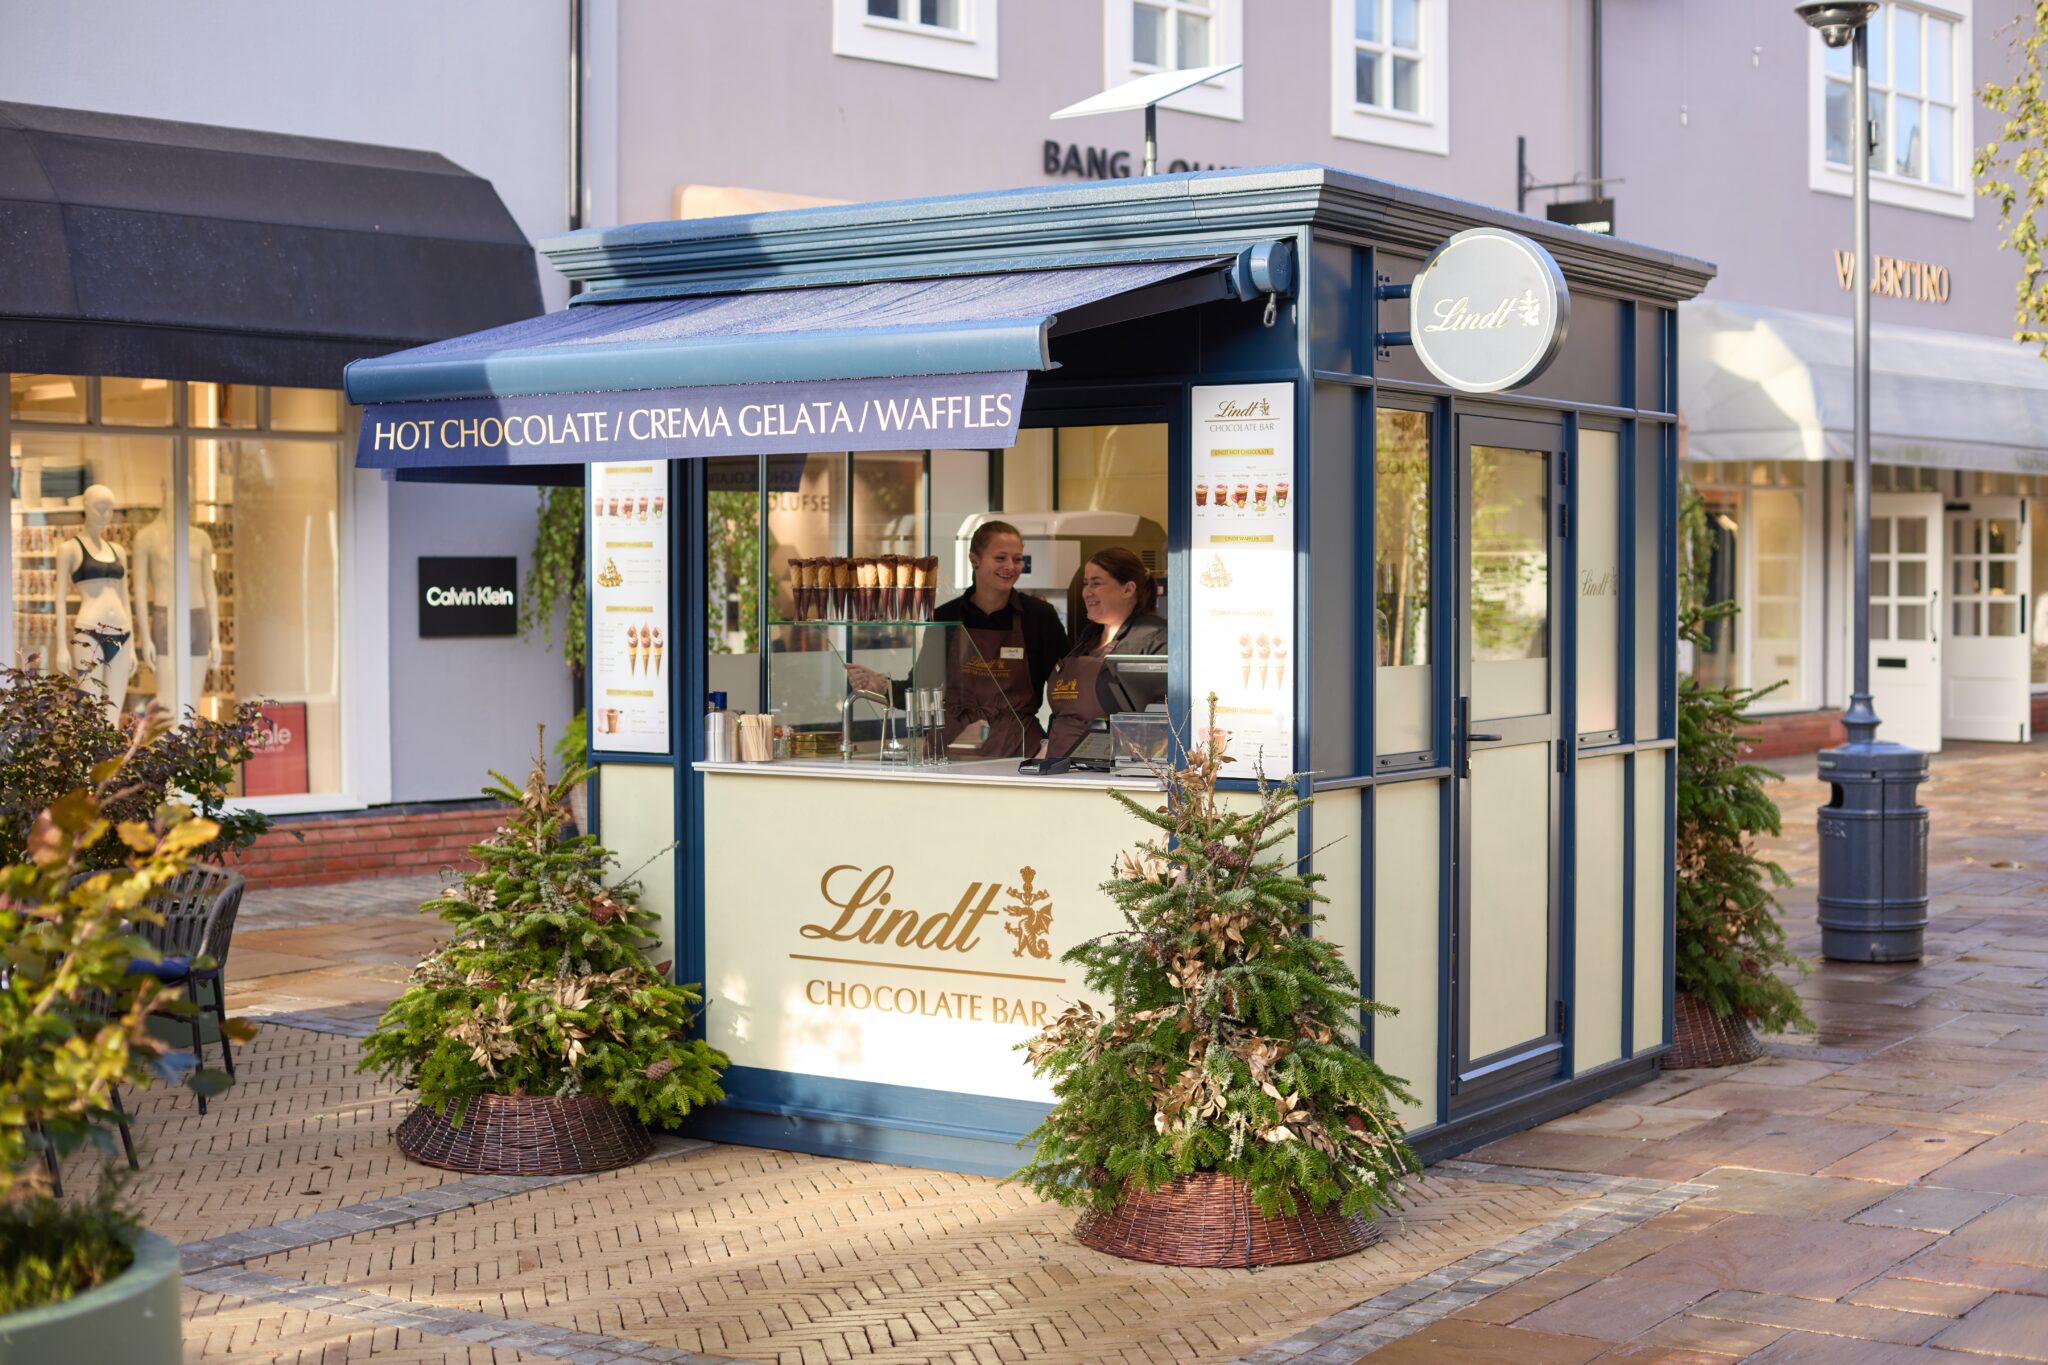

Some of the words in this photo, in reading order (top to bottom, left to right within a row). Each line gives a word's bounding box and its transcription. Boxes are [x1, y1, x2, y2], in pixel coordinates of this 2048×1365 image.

[1044, 140, 1130, 179] BANG
[1833, 248, 1951, 304] VENTINO
[1424, 297, 1518, 332] Lindt
[373, 420, 435, 451] HOT
[440, 411, 609, 449] CHOCOLATE
[629, 406, 733, 440] CREMA
[738, 400, 854, 438] GELATA
[873, 393, 1013, 432] WAFFLES
[1209, 423, 1258, 433] CHOCOLATE
[1259, 422, 1275, 431] BAR
[1214, 399, 1259, 418] Lindt
[426, 586, 476, 606] Calvin
[477, 586, 514, 606] Klein
[799, 864, 1002, 953] Lindt
[805, 979, 983, 1022] CHOCOLATE
[992, 996, 1048, 1028] BAR
